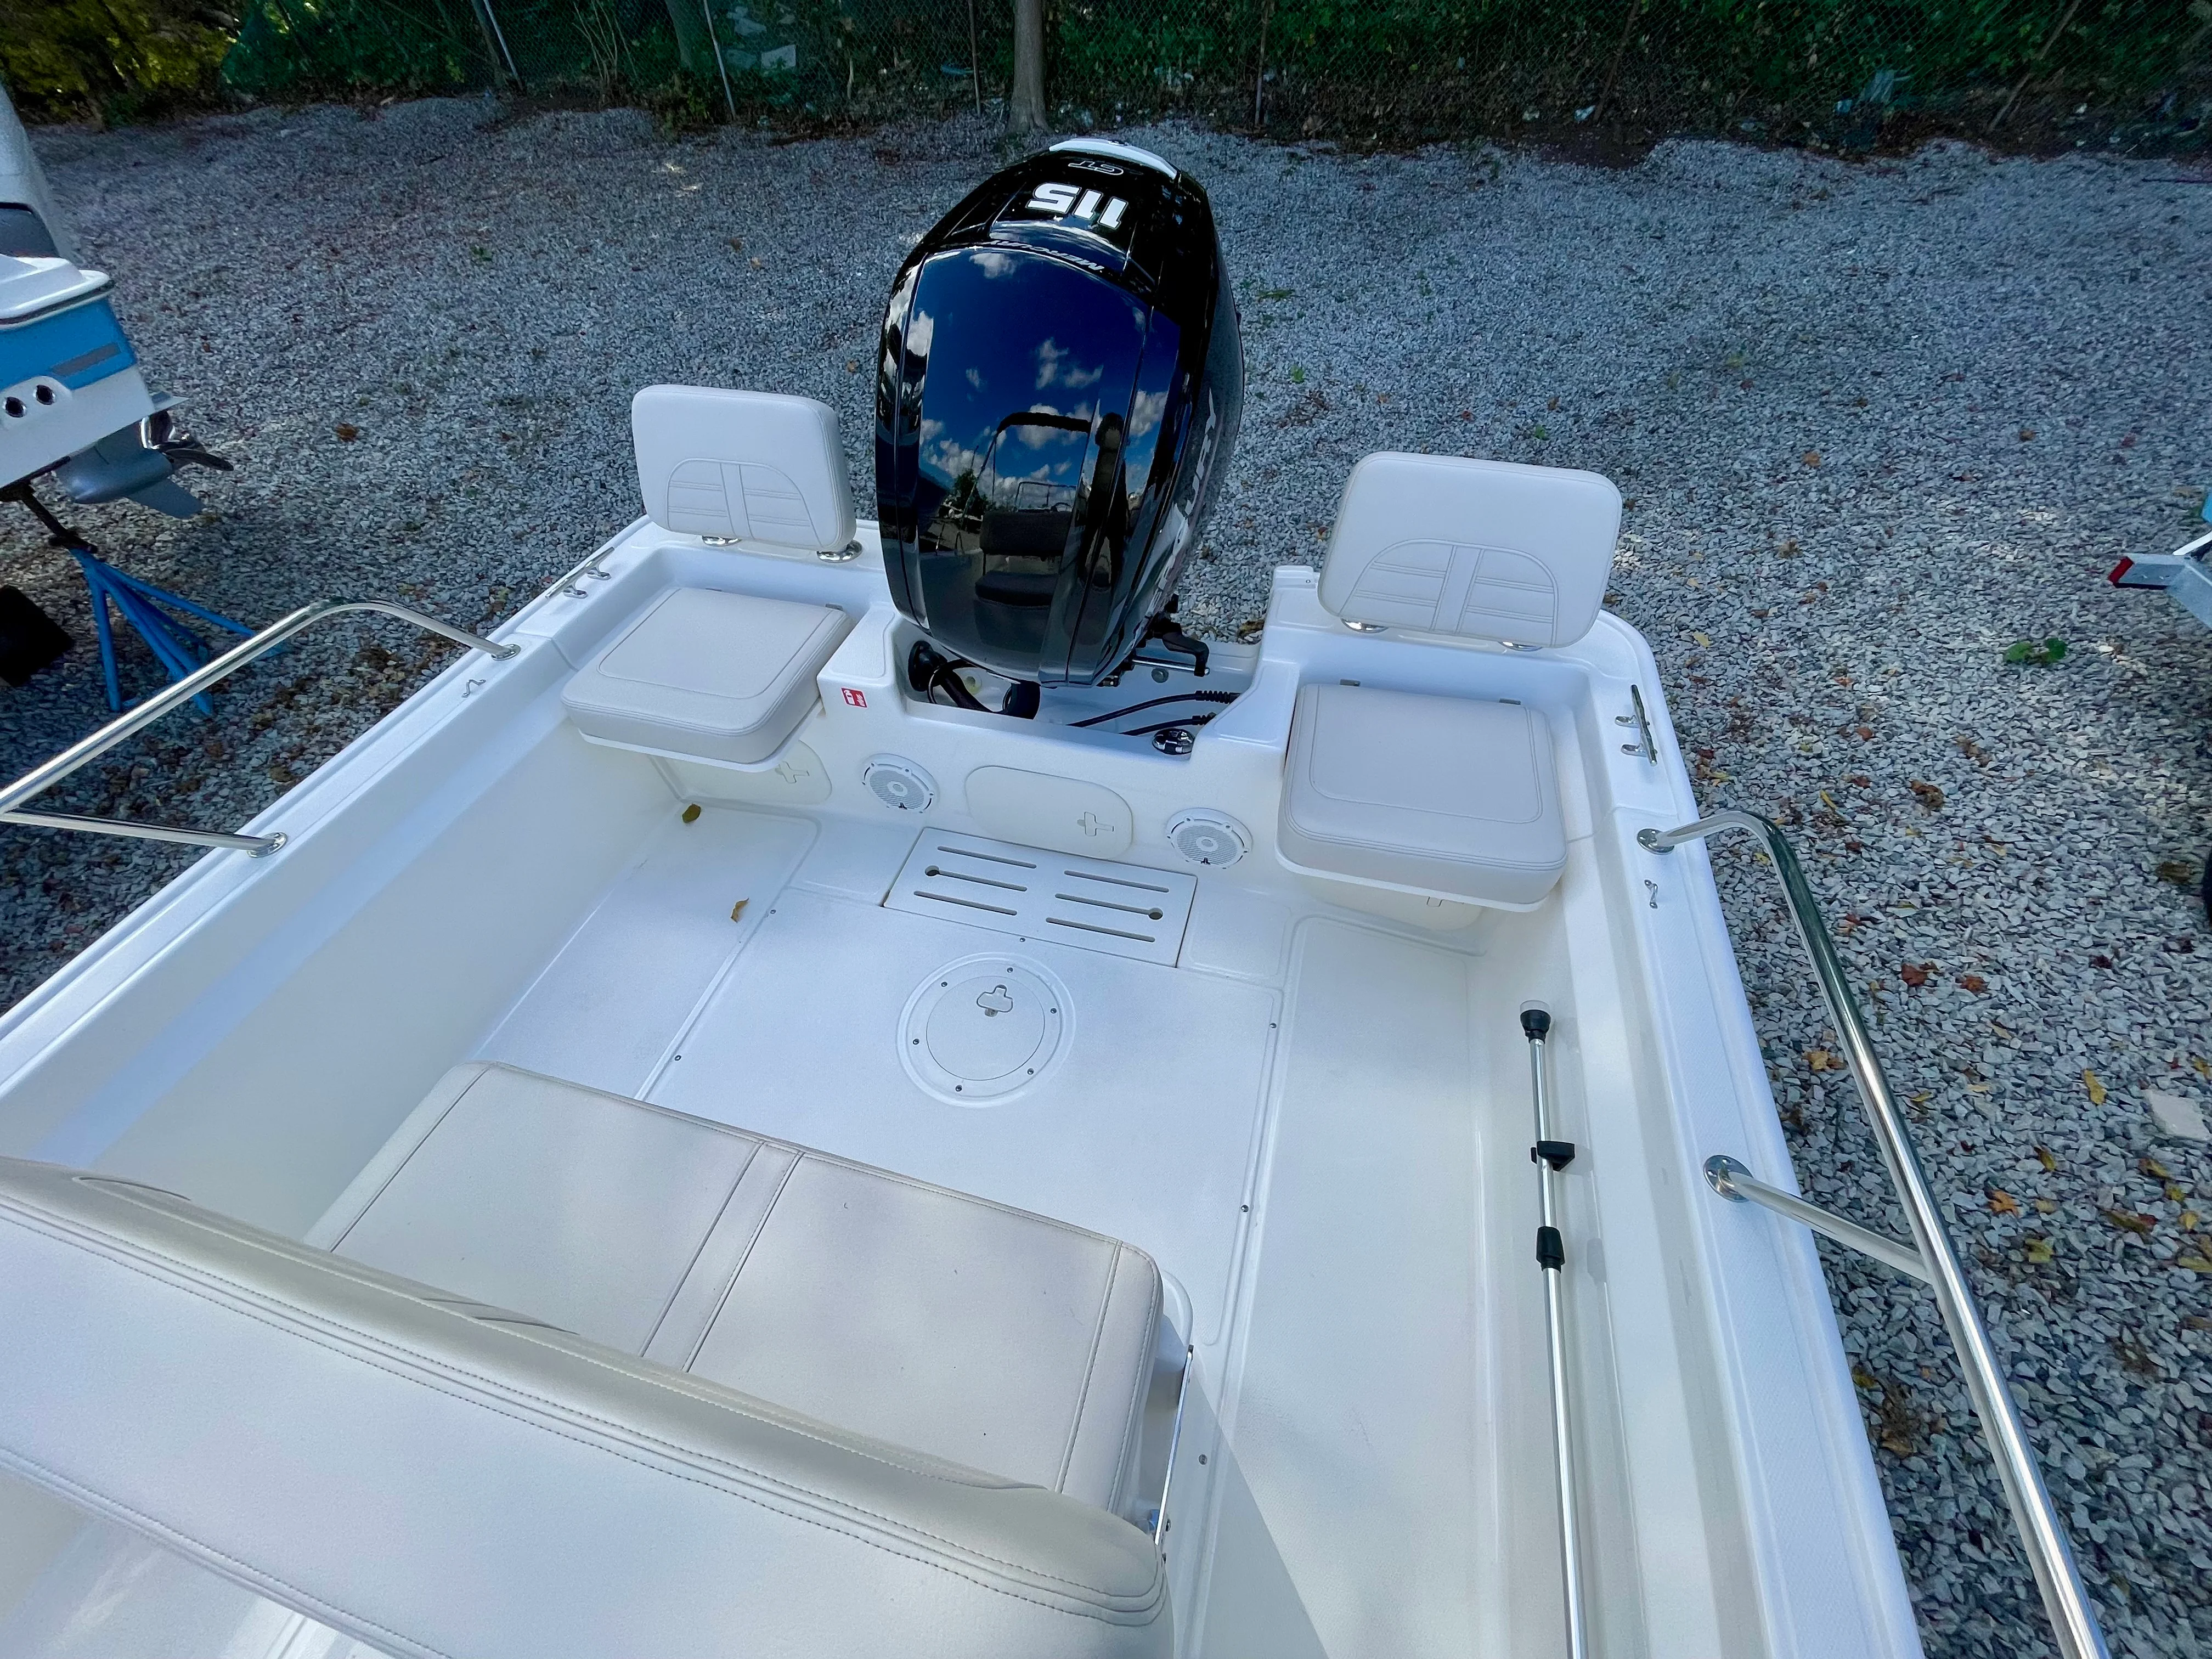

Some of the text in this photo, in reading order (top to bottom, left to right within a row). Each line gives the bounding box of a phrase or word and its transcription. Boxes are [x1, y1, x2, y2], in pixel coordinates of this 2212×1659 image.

[1068, 160, 1124, 176] GT
[1025, 181, 1129, 230] 115
[980, 240, 1105, 270] MERCURY
